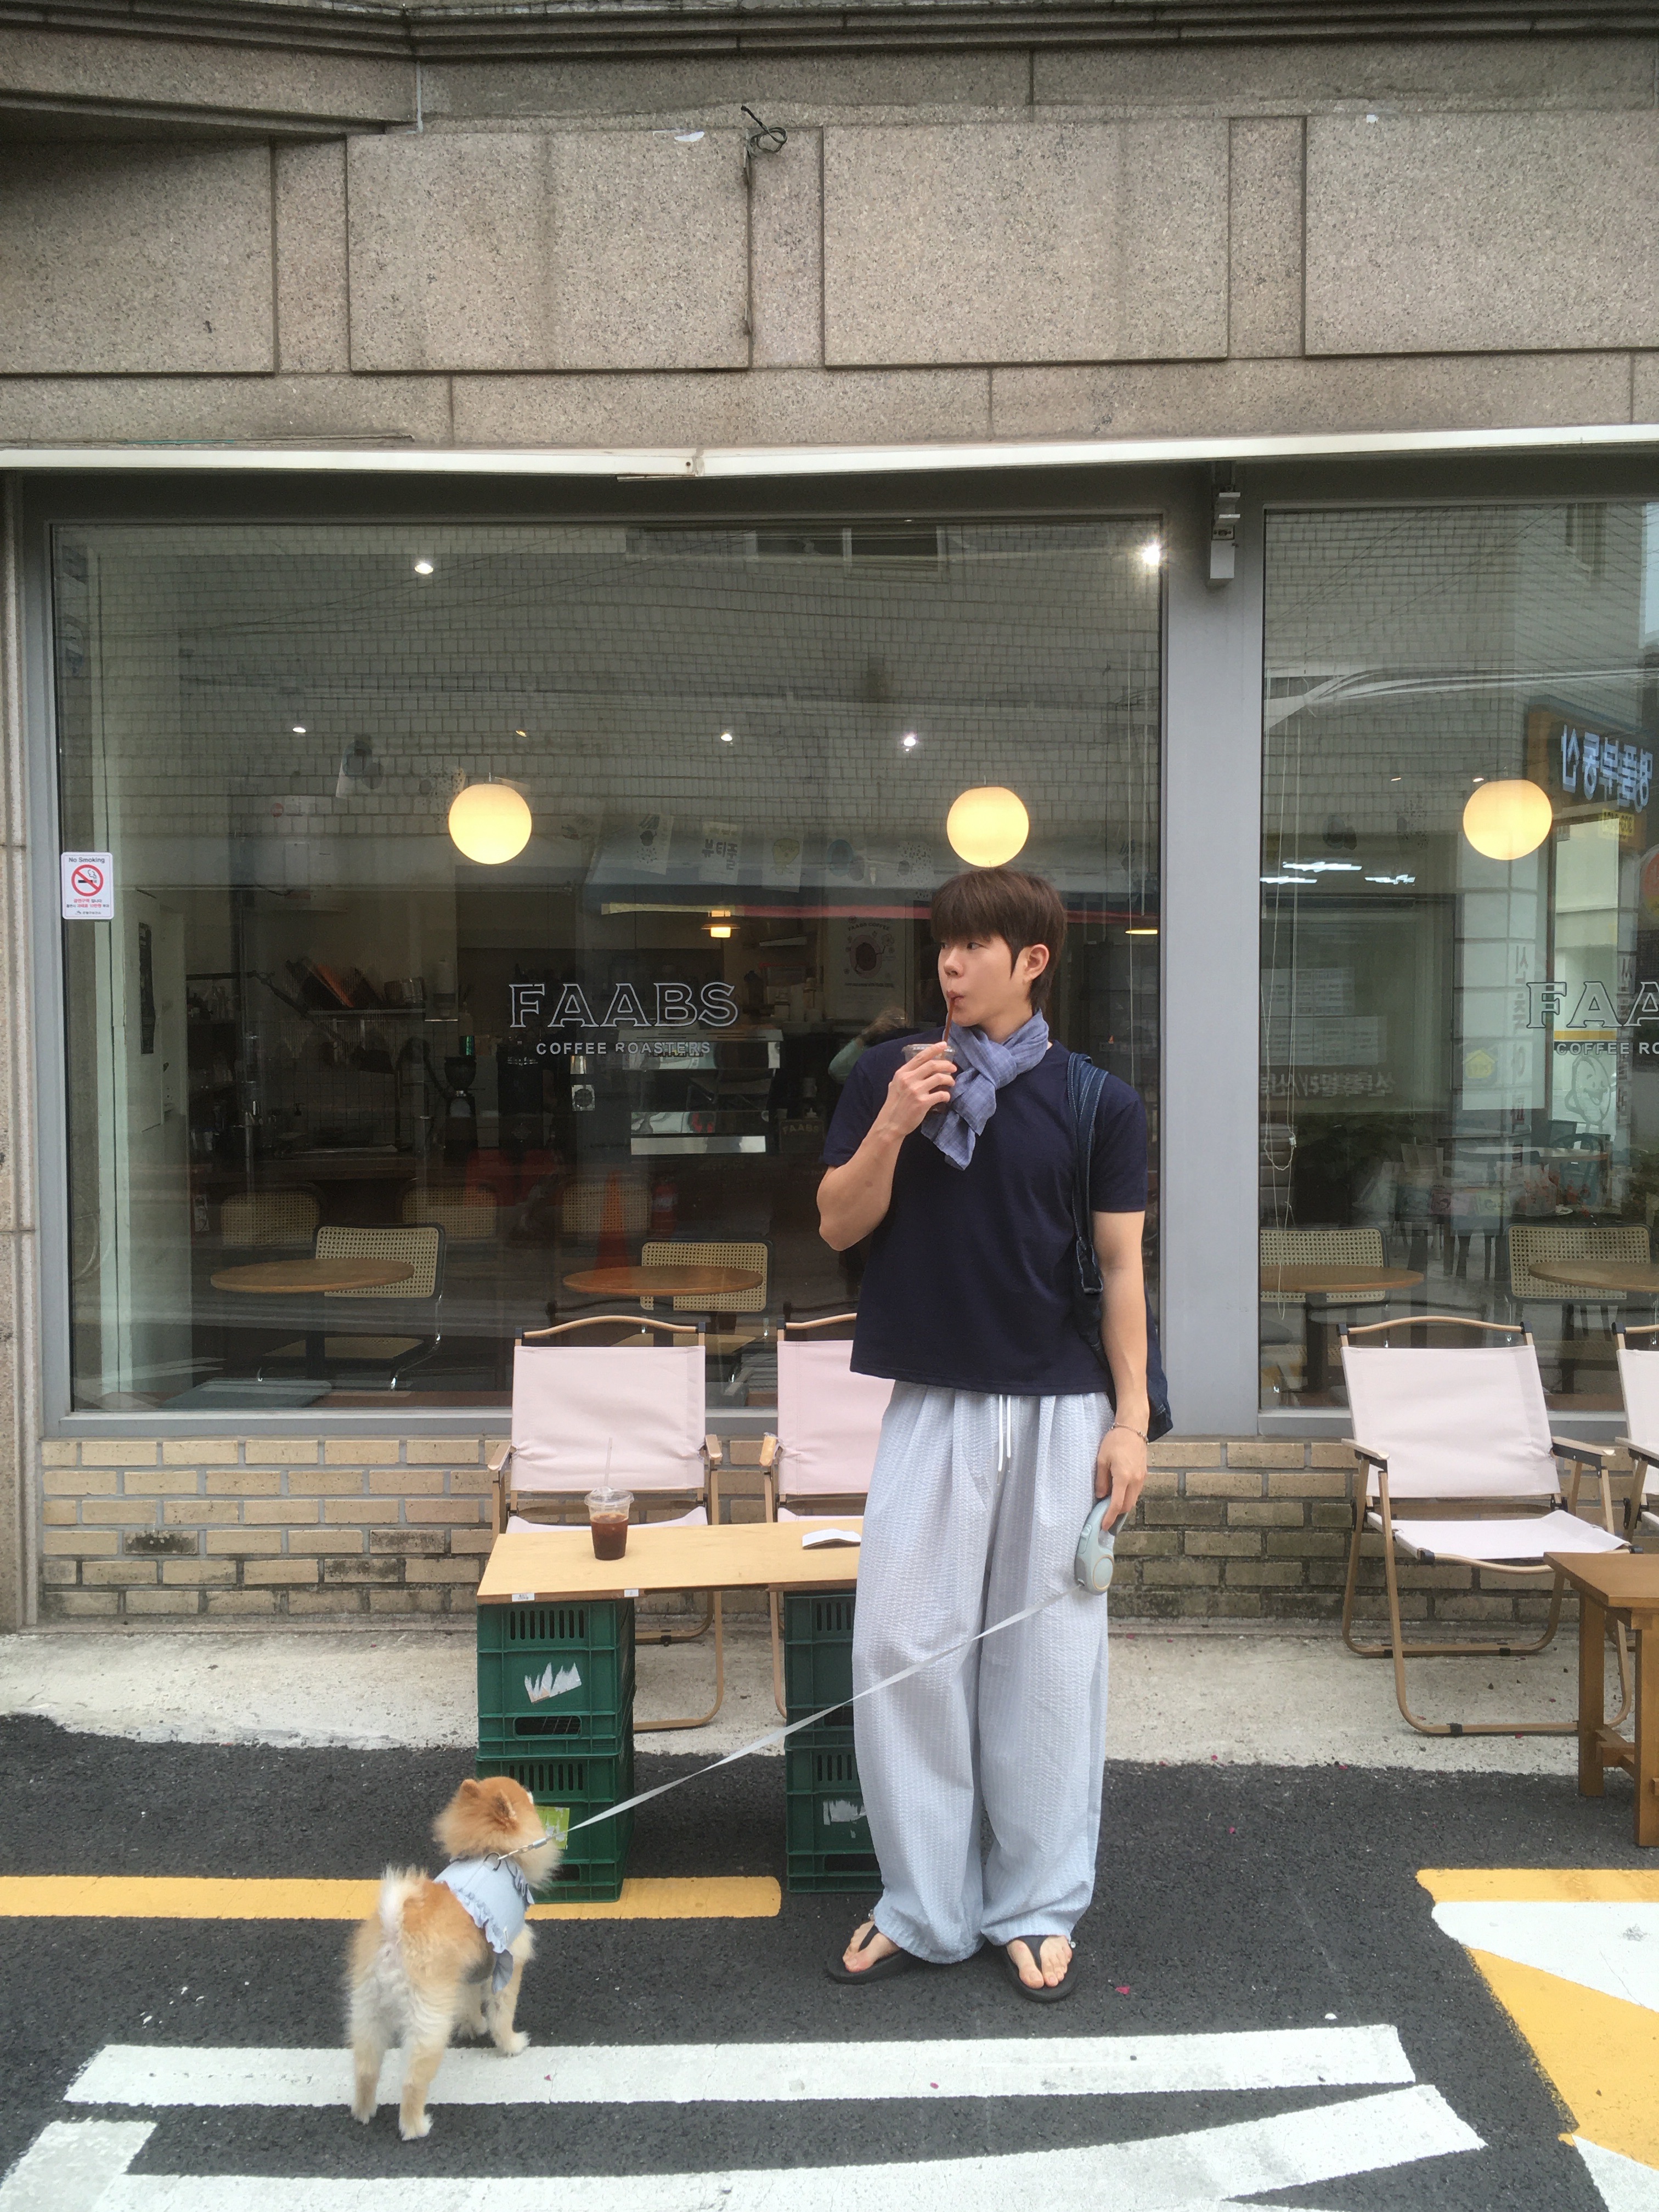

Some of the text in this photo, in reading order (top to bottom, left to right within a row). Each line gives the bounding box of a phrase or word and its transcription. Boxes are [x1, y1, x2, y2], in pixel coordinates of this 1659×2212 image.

[509, 982, 738, 1028] FAABS
[537, 1042, 710, 1055] COFFEE ROASTERS
[1556, 1043, 1630, 1056] COFFEE
[782, 1124, 820, 1135] FAABS
